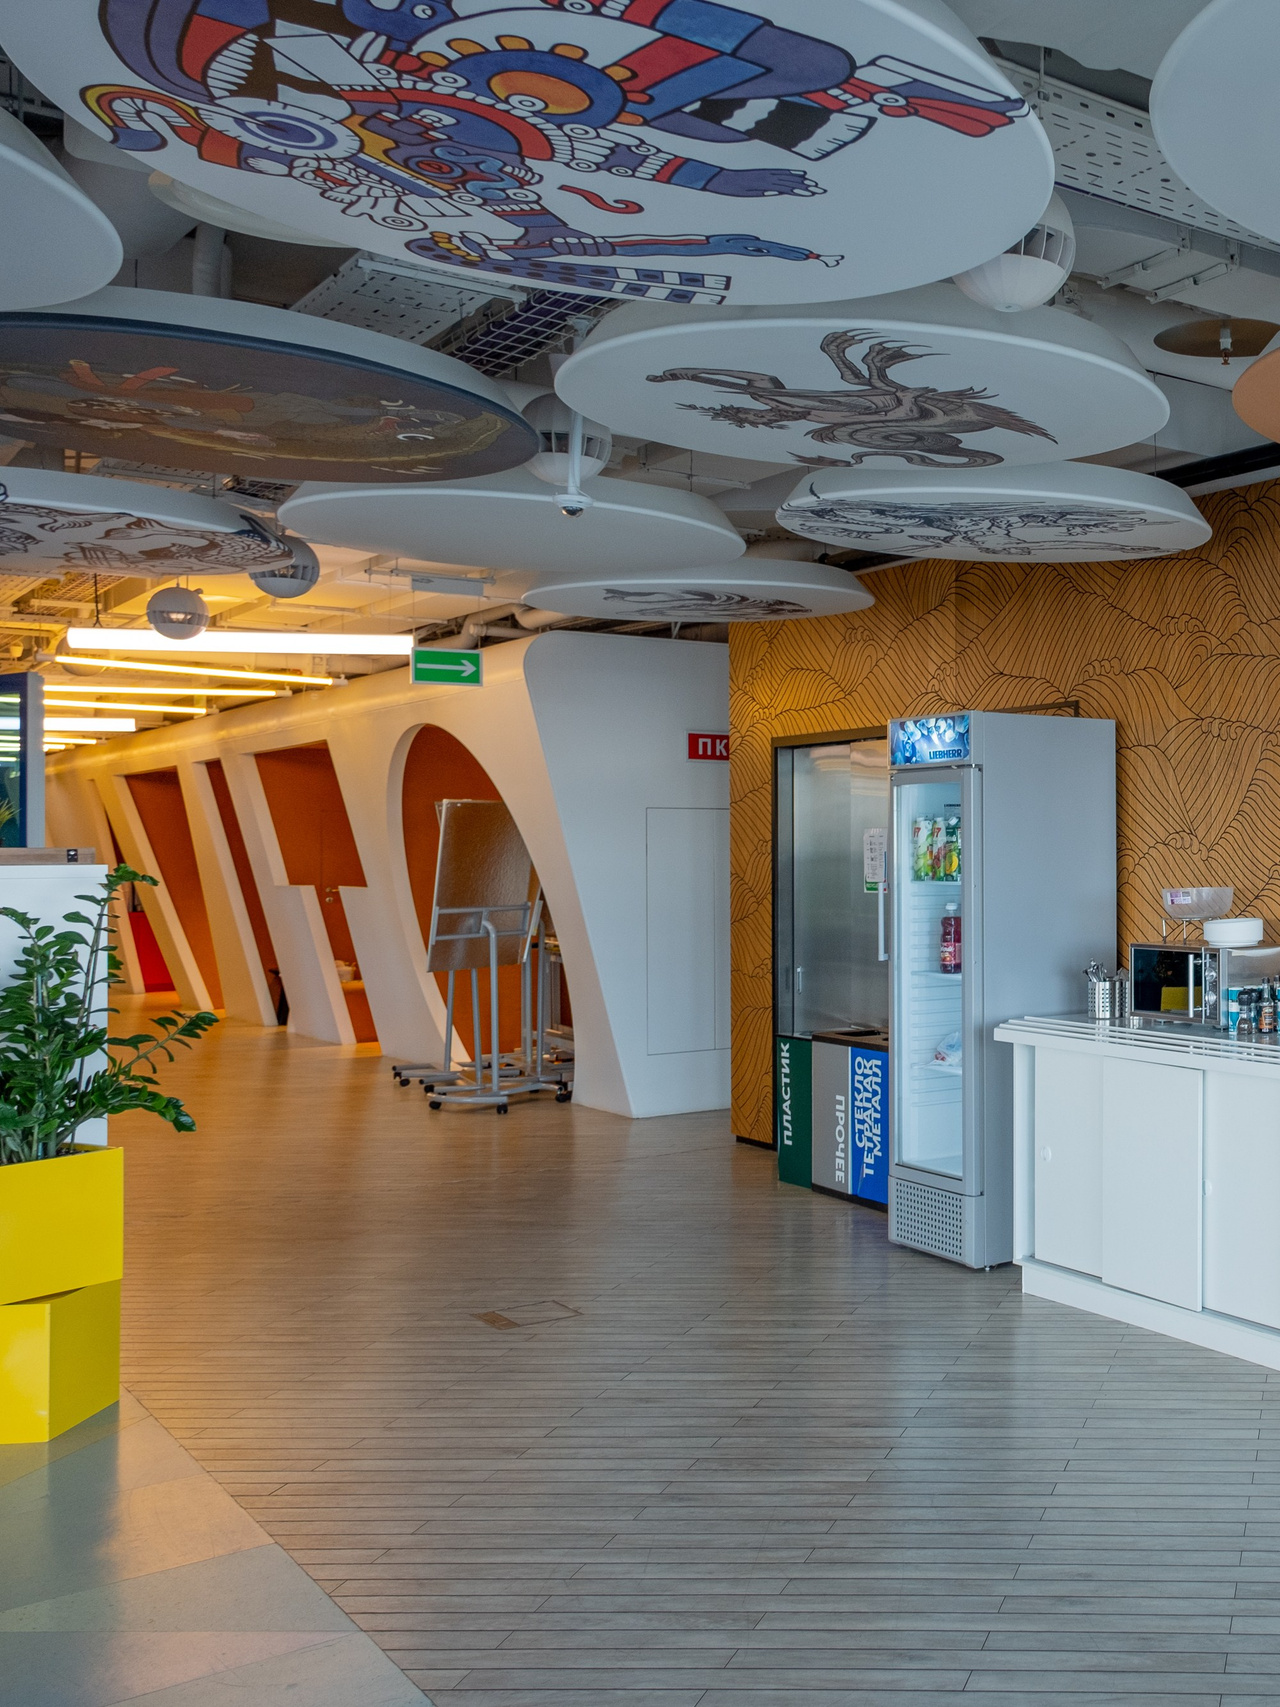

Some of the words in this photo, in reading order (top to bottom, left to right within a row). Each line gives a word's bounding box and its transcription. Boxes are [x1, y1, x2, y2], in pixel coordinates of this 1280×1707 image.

[698, 737, 728, 757] ПК
[928, 748, 963, 760] LIEBHERR
[780, 1042, 793, 1146] ПЛАСТИК
[835, 1094, 846, 1184] ПРОЧЕЕ
[854, 1056, 865, 1148] СТЕКЛО
[863, 1058, 875, 1178] ТЕТРАПАК
[871, 1058, 882, 1157] МЕТАЛЛ
